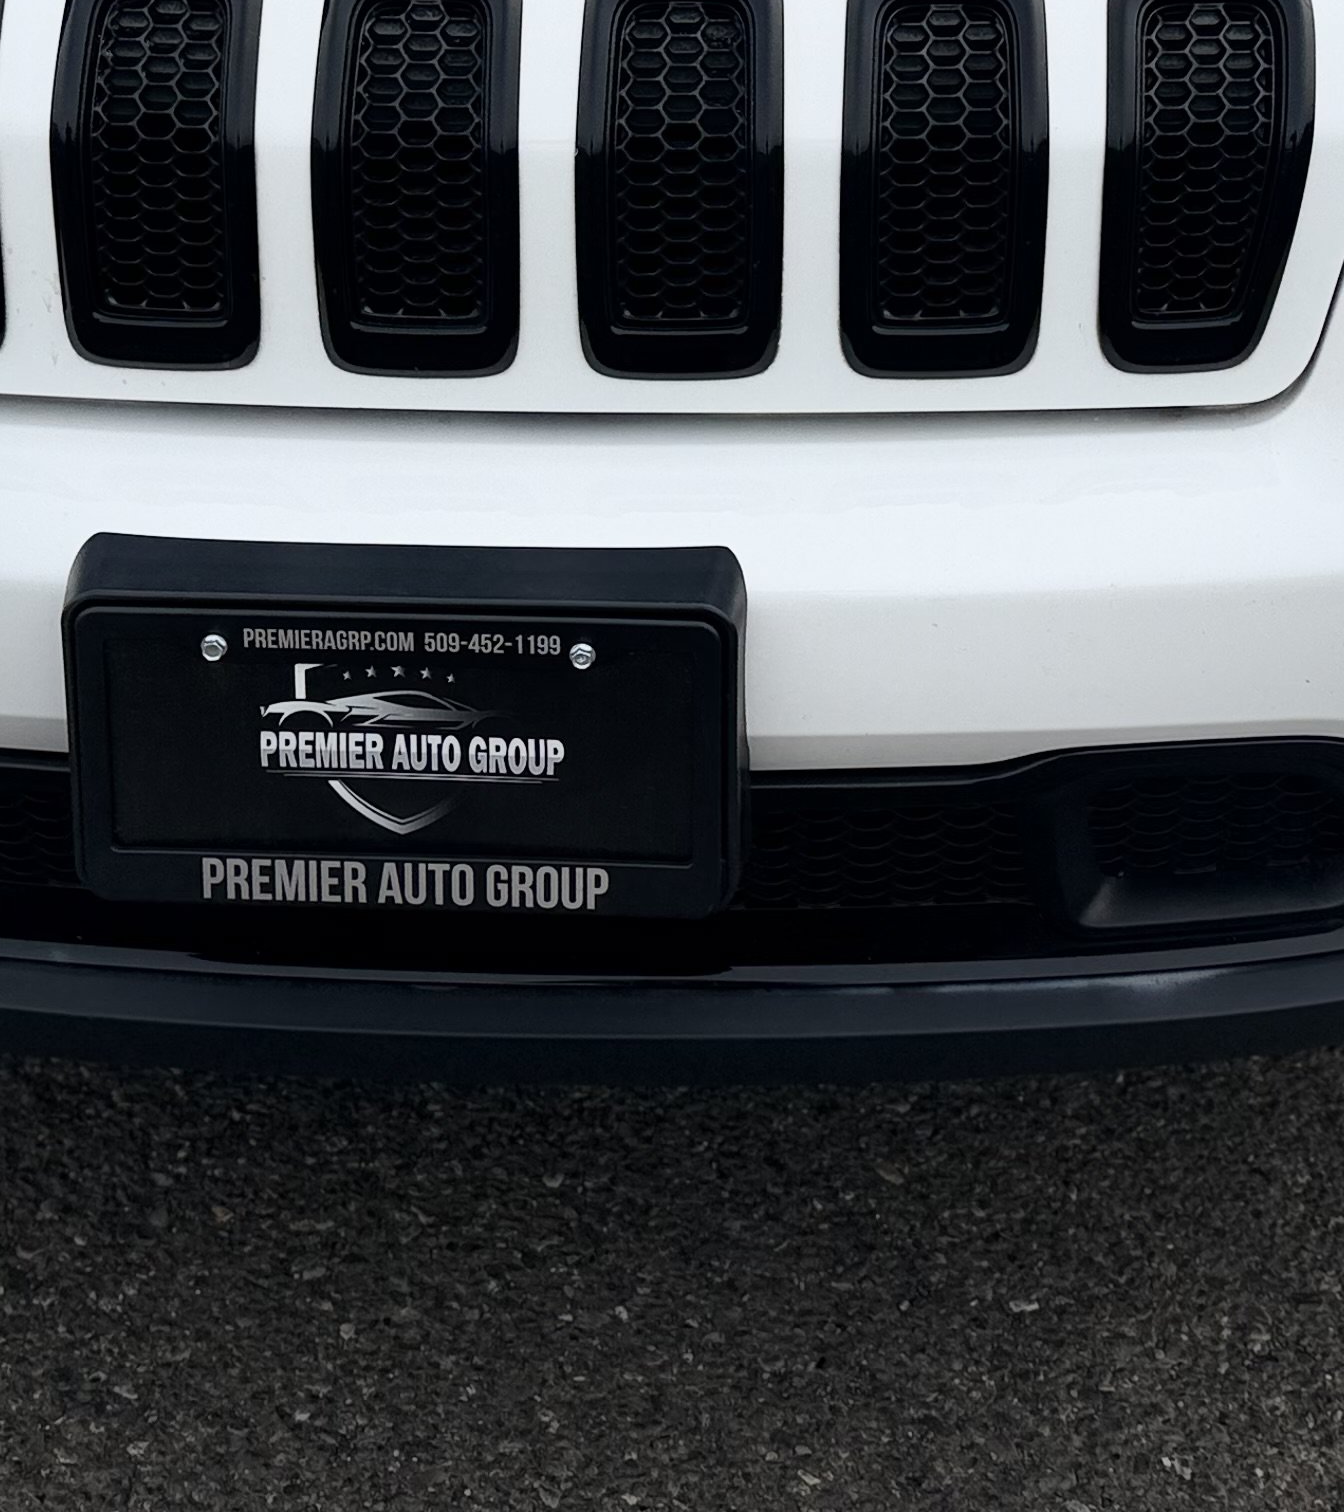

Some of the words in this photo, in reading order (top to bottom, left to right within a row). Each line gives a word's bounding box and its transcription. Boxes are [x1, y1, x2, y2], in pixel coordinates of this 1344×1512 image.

[243, 628, 414, 652] PREMIERAGRP.COM
[424, 632, 561, 655] 509-452-1199
[260, 731, 384, 769] PREMIER
[392, 734, 461, 772] AUTO
[469, 736, 565, 776] GROUP
[202, 857, 367, 904] PREMIER
[378, 861, 475, 906] AUTO
[486, 865, 610, 909] GROUP
